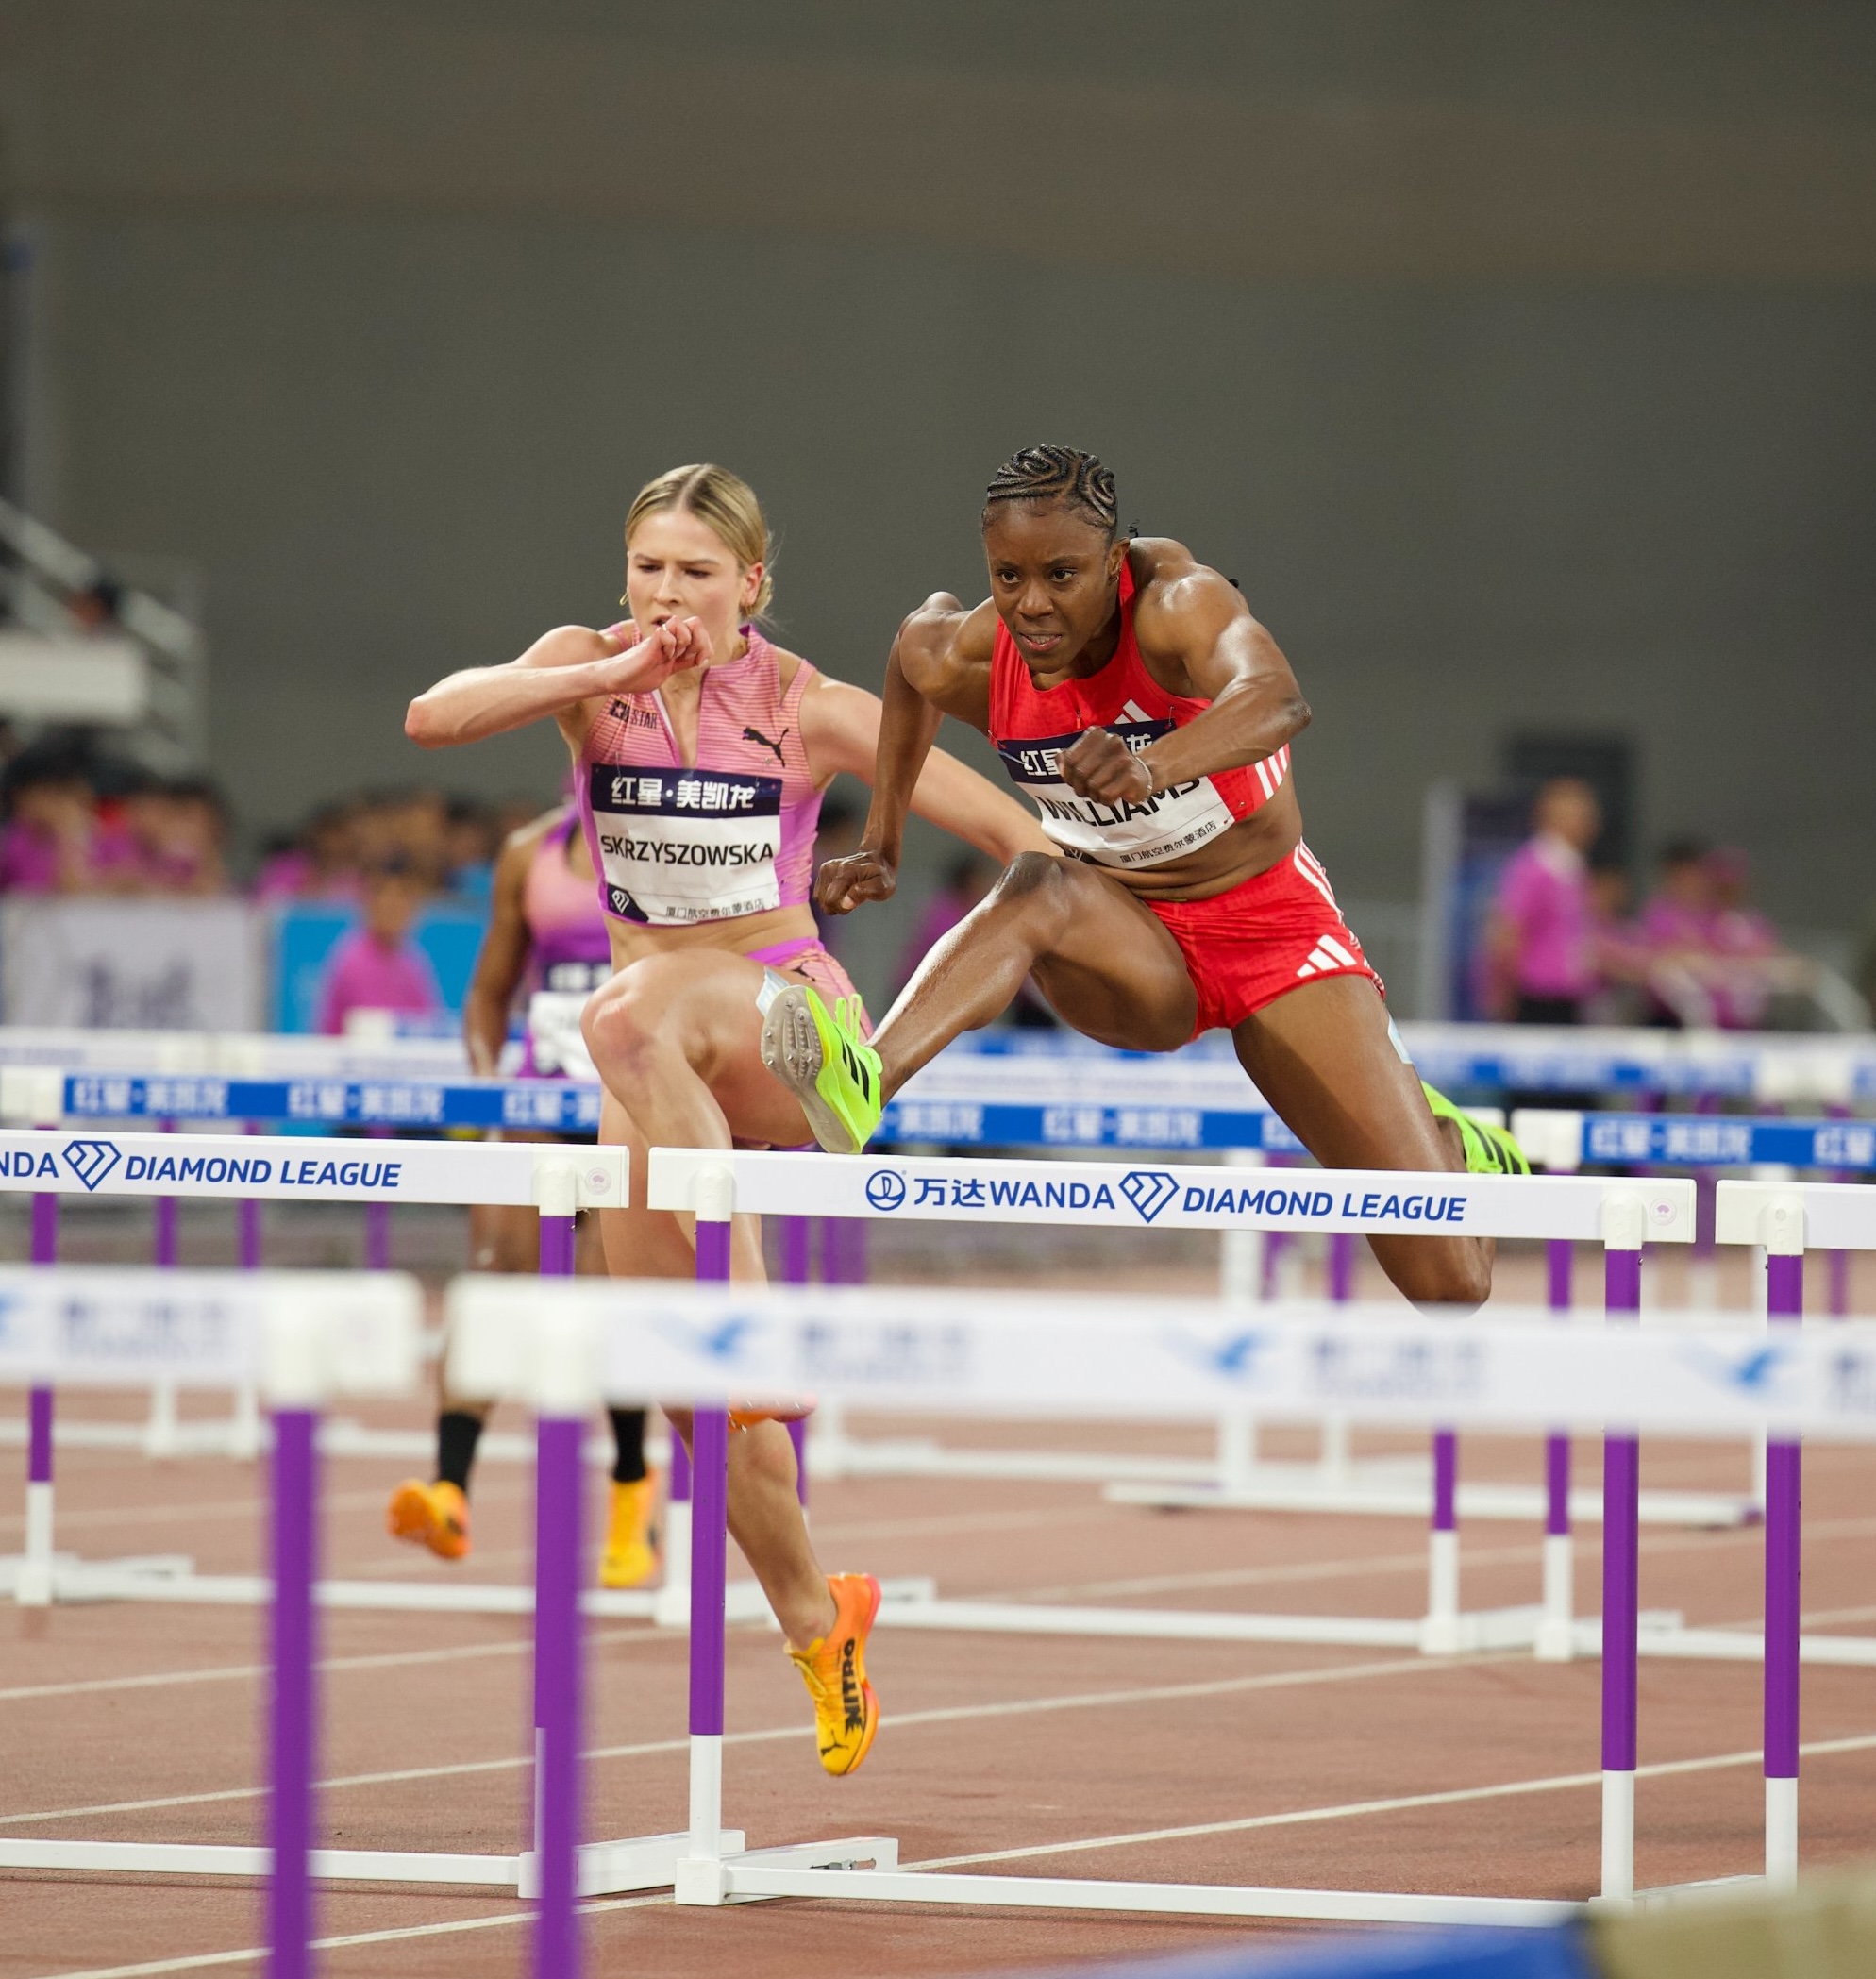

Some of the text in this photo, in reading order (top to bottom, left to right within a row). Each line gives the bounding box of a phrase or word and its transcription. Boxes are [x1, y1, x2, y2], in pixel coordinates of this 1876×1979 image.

[631, 708, 658, 729] STAR
[600, 834, 774, 866] SKRZYSZOWSKA
[125, 1155, 272, 1183] DIAMOND
[280, 1161, 402, 1188] LEAGUE
[1182, 1187, 1333, 1216] DIAMOND
[1341, 1193, 1467, 1222] LEAGUE
